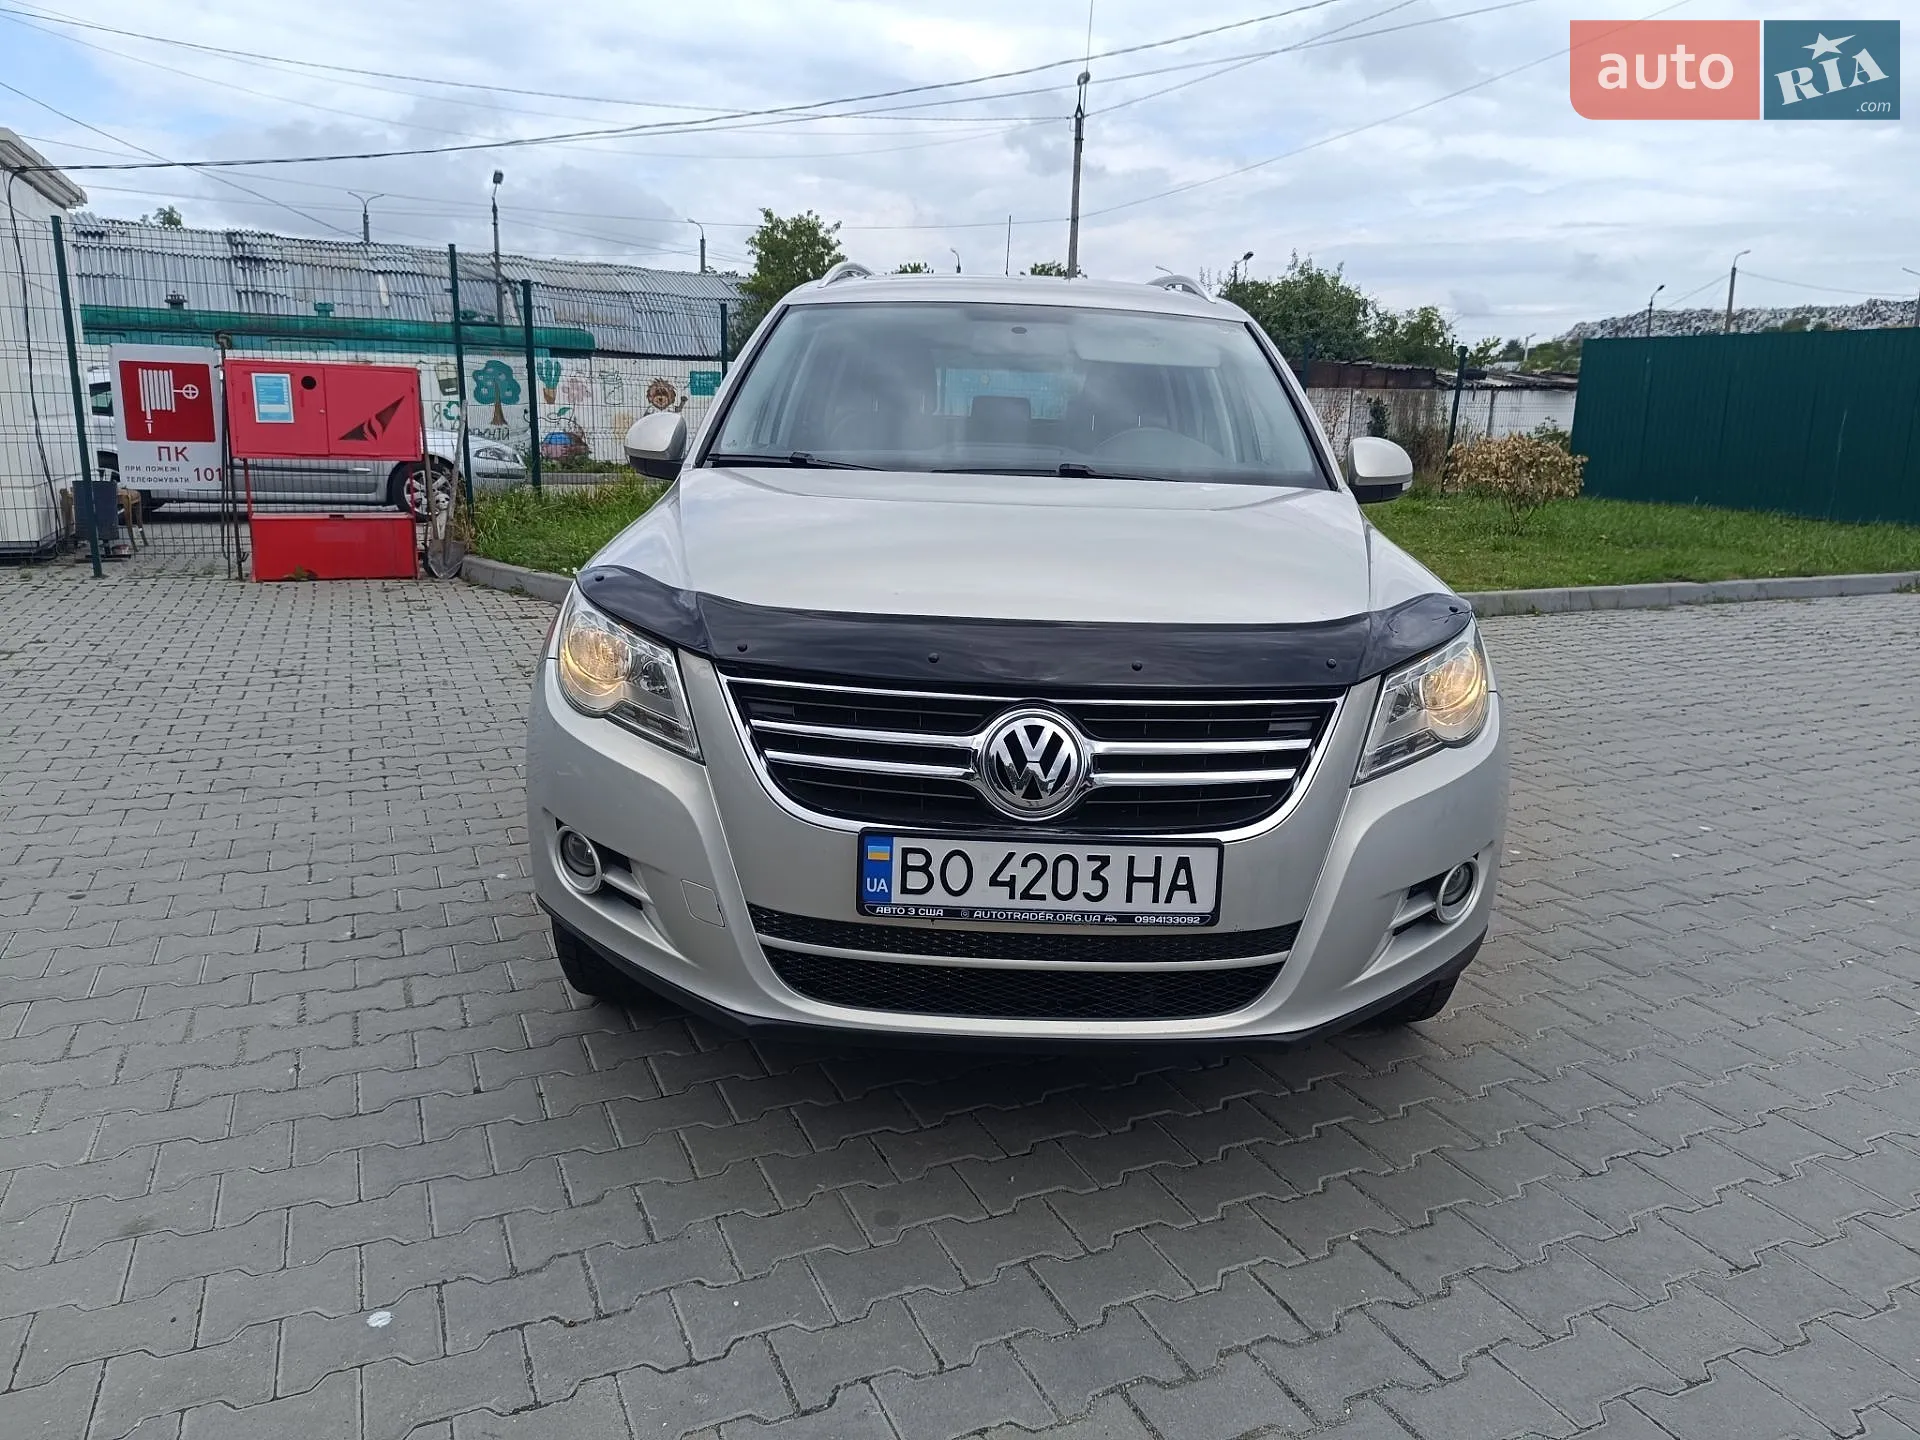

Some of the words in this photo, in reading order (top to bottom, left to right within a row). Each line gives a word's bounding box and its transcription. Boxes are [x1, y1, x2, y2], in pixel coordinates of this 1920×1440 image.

[157, 446, 190, 462] ПК
[193, 467, 223, 482] 101
[900, 847, 974, 897] BO
[988, 851, 1111, 903] 4203
[1125, 855, 1197, 904] HA
[866, 877, 889, 893] UA
[875, 906, 905, 915] АВТО
[918, 908, 944, 917] США
[973, 910, 1101, 923] AUTOTRADER.ORG.UA
[1134, 915, 1201, 924] 0994133092
